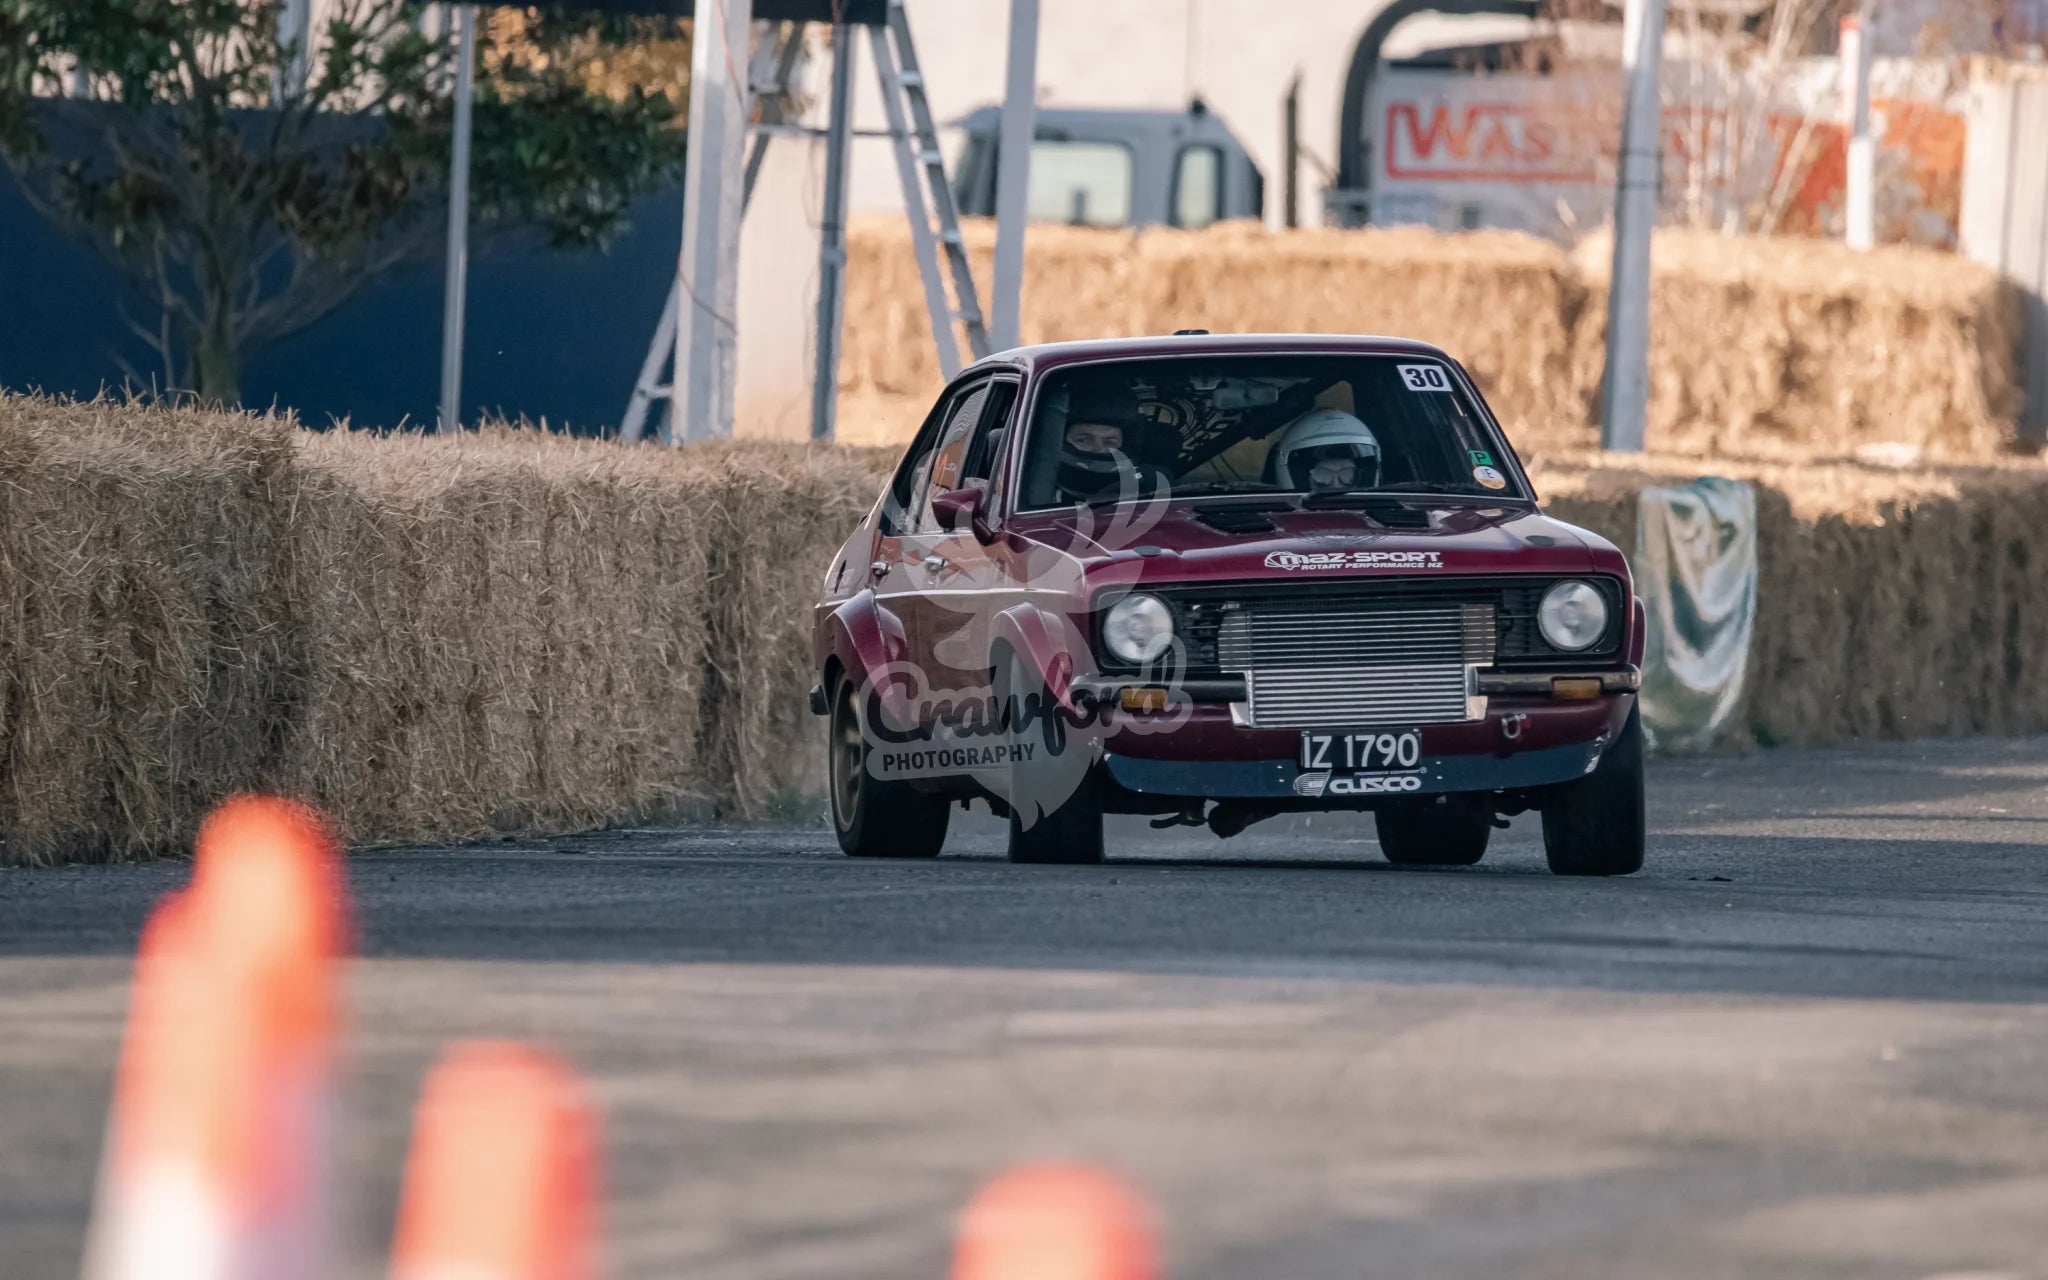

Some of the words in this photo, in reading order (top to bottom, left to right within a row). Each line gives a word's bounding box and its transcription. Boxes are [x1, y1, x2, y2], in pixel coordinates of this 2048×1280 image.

[1405, 368, 1444, 388] 30
[1475, 452, 1487, 463] P
[1301, 563, 1342, 571] ROTARY
[1303, 735, 1333, 769] IZ
[1344, 733, 1419, 768] 1790
